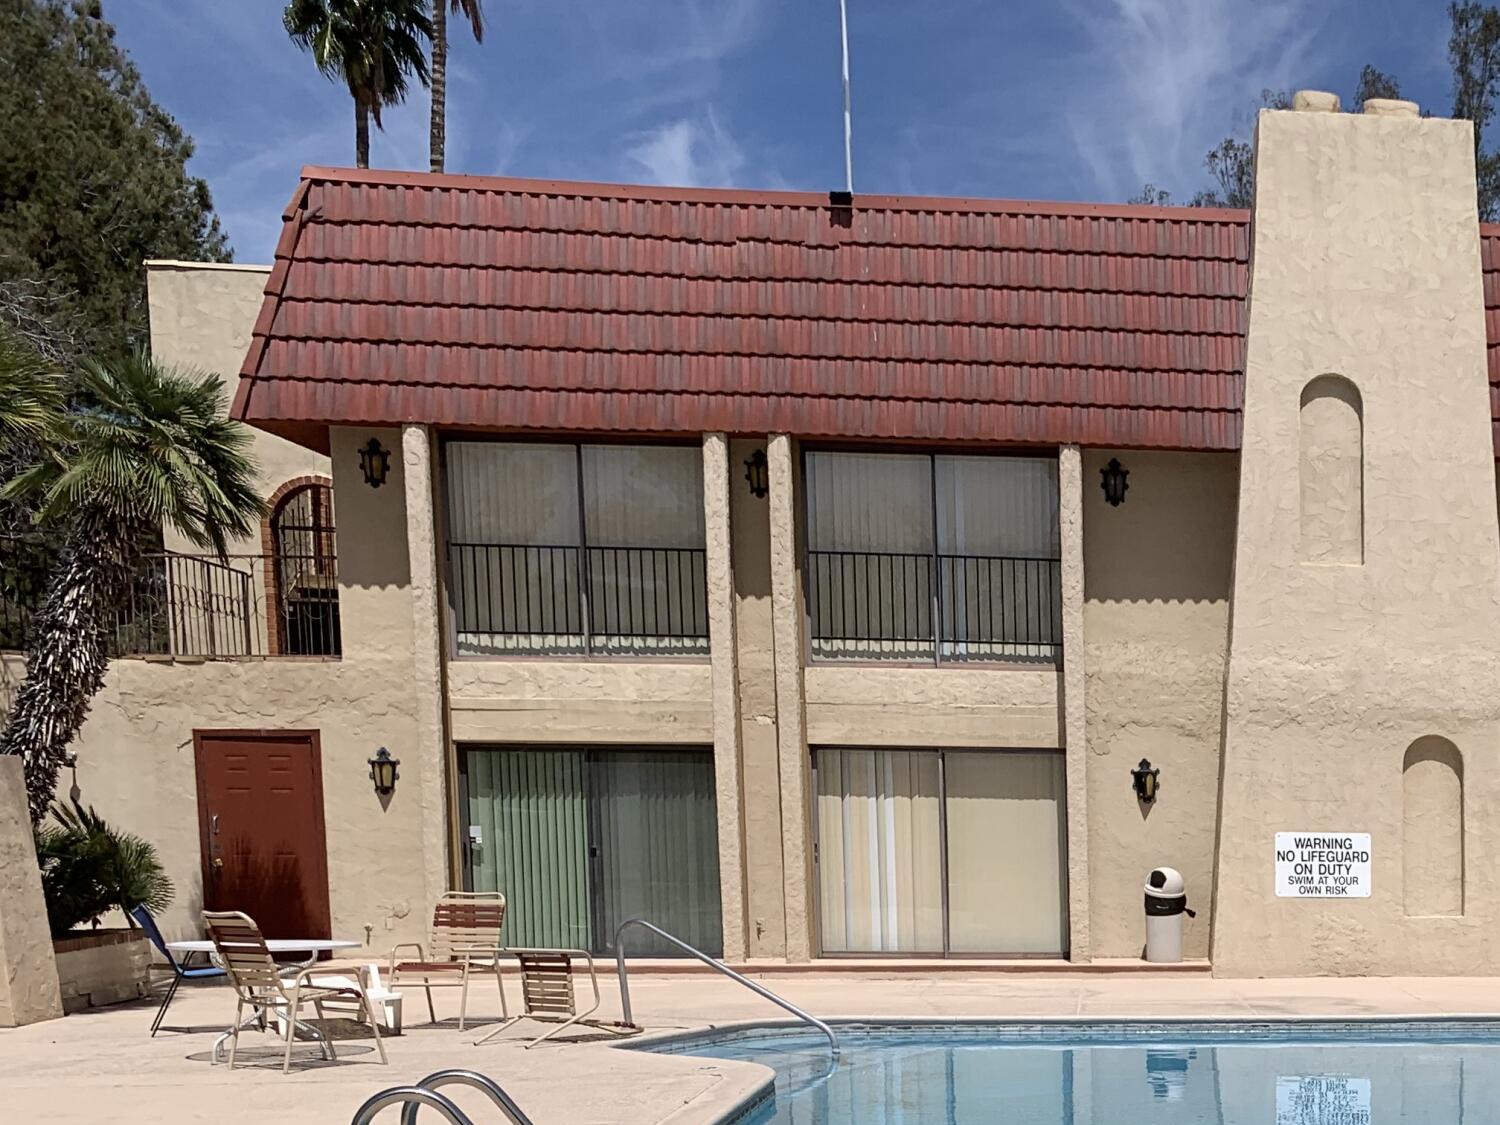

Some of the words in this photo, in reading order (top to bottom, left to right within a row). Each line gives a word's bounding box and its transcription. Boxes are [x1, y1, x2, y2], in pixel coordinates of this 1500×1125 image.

[1294, 837, 1353, 850] WARNING
[1277, 850, 1295, 862] NO
[1300, 850, 1369, 863] LIFEGUARD
[1294, 863, 1312, 875] ON
[1318, 863, 1352, 876] DUTY
[1287, 875, 1314, 885] SWIM
[1317, 875, 1329, 885] AT
[1332, 875, 1359, 886] YOUR
[1298, 885, 1322, 895] OWN
[1325, 885, 1348, 895] RISK
